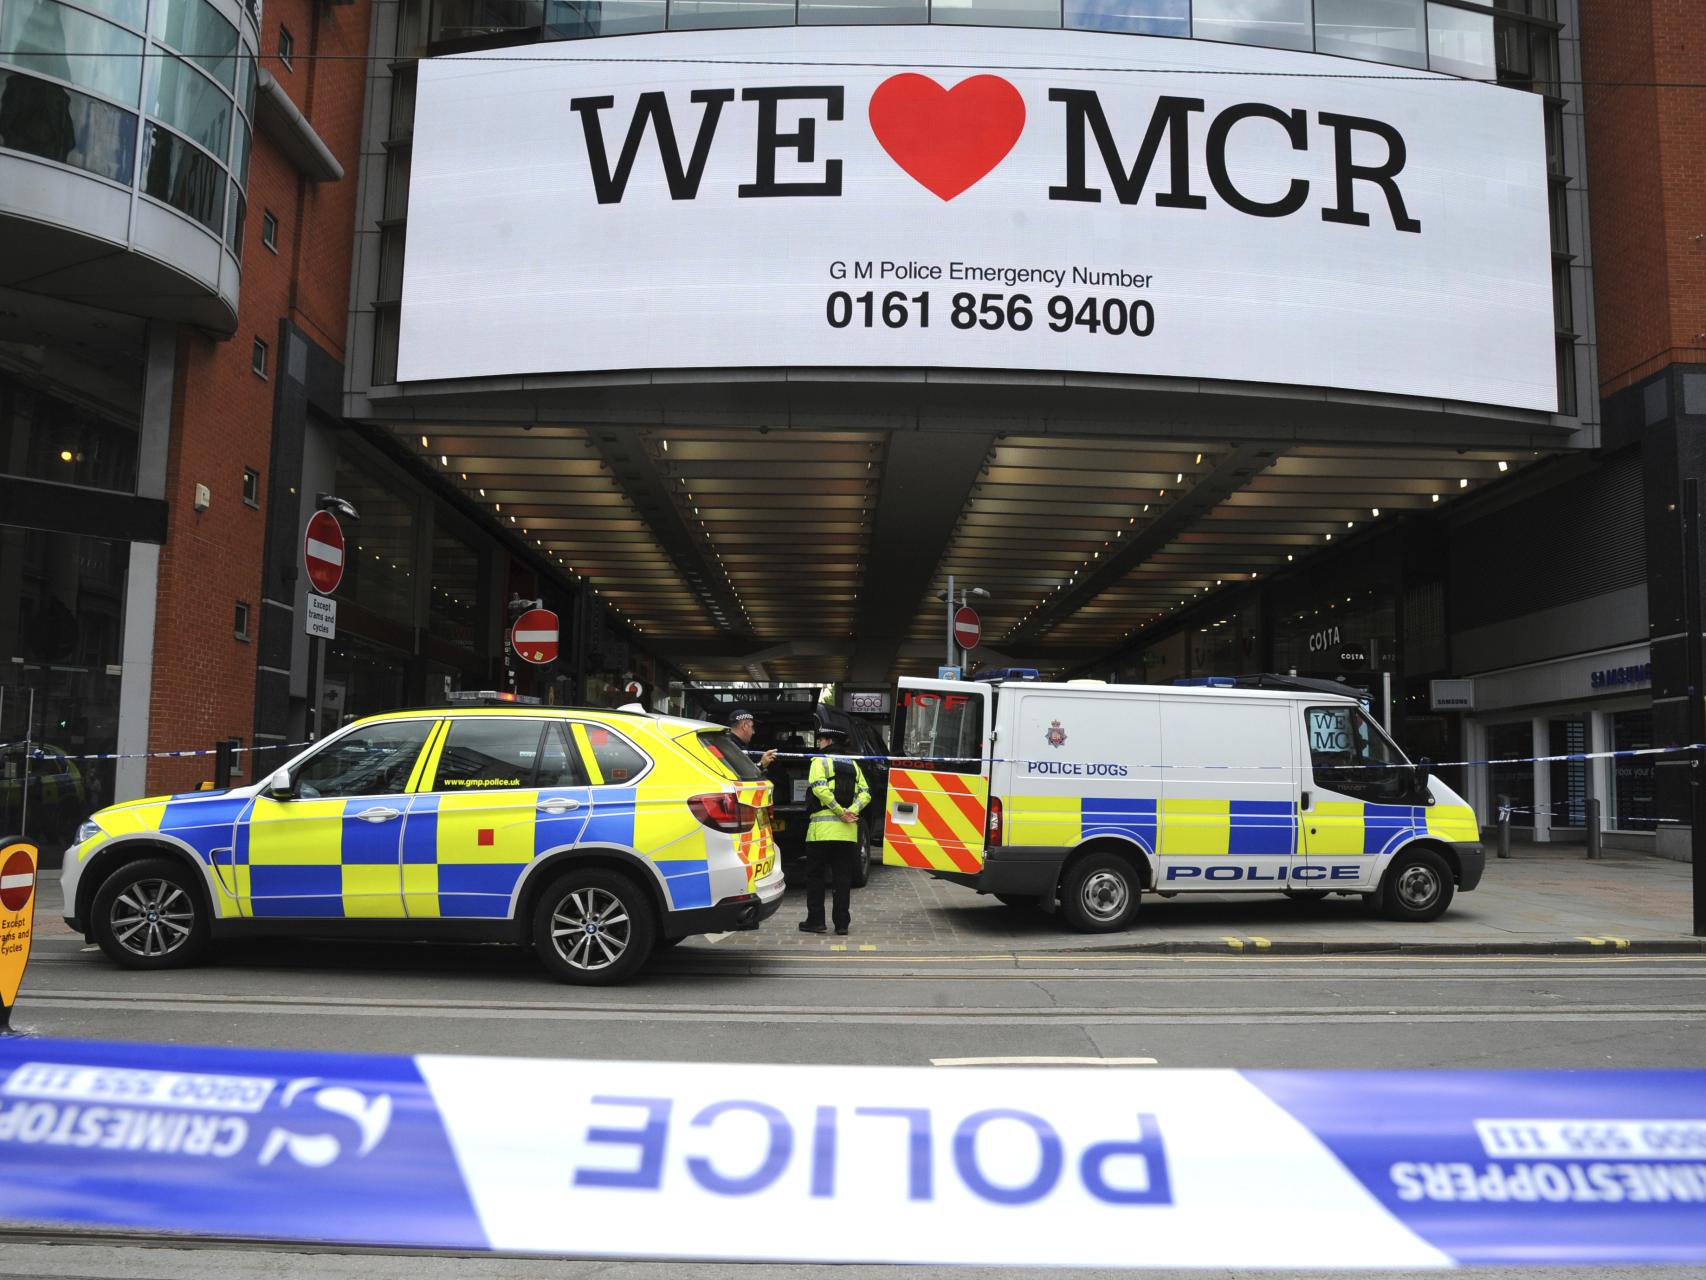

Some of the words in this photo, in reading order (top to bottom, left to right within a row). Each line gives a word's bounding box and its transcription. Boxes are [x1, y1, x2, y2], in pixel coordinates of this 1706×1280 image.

[570, 86, 844, 204] WE
[1049, 88, 1421, 233] MCR
[830, 262, 846, 279] G
[855, 262, 872, 278] M
[881, 262, 941, 279] Police
[950, 263, 1065, 287] Emergency
[1073, 267, 1152, 288] Number
[827, 291, 928, 328] 0161
[951, 292, 1032, 331] 856
[1048, 295, 1154, 337] 9400
[313, 599, 331, 611] Except
[309, 609, 323, 620] trams
[325, 615, 335, 623] and
[312, 624, 329, 633] cycles
[1309, 626, 1340, 651] COSTA
[851, 692, 883, 707] food
[1314, 715, 1346, 730] WE
[1314, 732, 1351, 750] MC
[1028, 761, 1082, 775] POLICE
[1087, 763, 1128, 776] DOGS
[444, 778, 520, 787] www.gmp.police.uk
[1166, 865, 1361, 881] POLICE
[1, 918, 25, 929] Except
[18, 930, 29, 939] and
[1, 944, 23, 956] cycles
[172, 1078, 263, 1103] 0800
[0, 1100, 250, 1158] CRIMESTOP
[571, 1093, 1177, 1207] POLICE
[1389, 1162, 1706, 1202] IMESTOPPERS
